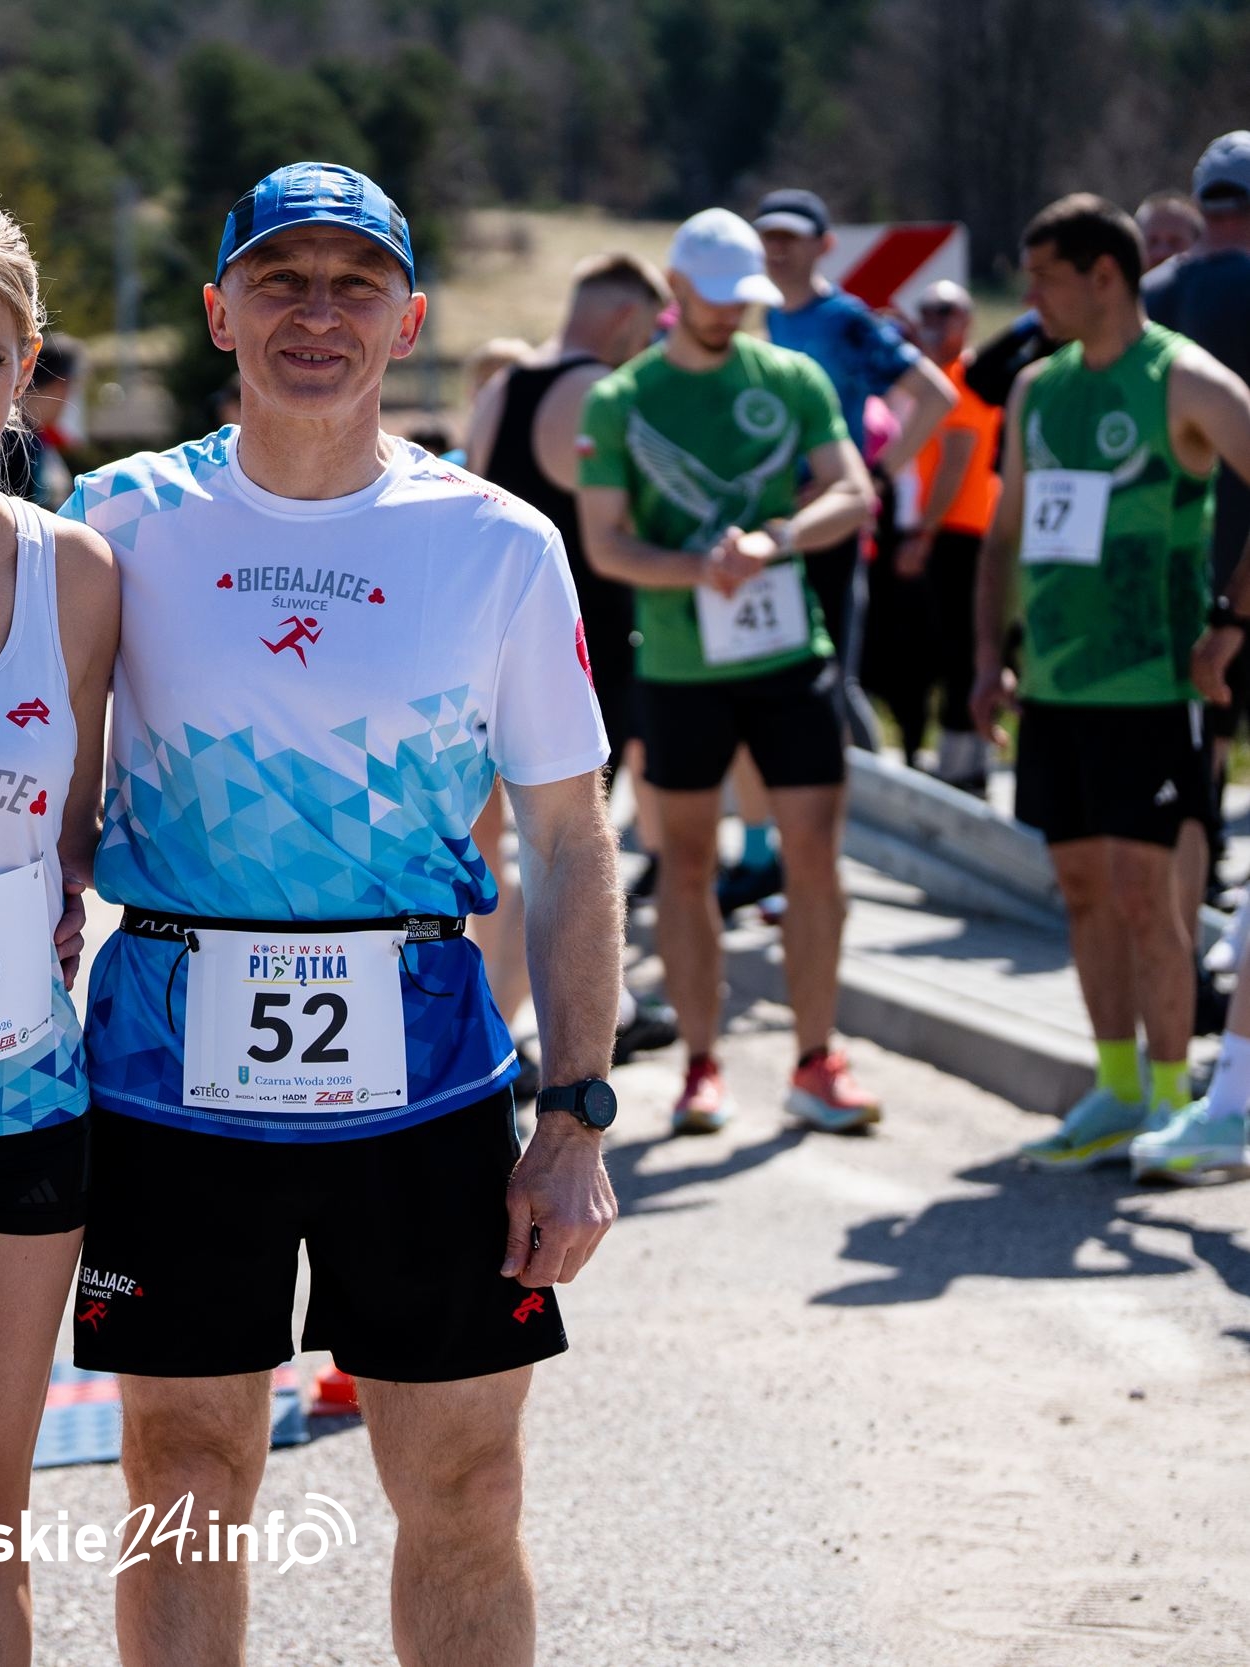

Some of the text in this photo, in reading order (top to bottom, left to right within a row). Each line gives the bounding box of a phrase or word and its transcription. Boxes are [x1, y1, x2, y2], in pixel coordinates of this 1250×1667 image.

[237, 566, 370, 604] BIEGAJĄCE
[272, 595, 328, 611] ŚLIWICE
[735, 598, 778, 630] 41
[246, 992, 349, 1064] 52
[195, 1084, 230, 1099] STEICO
[254, 1075, 352, 1086] Czarna Woda 2026
[78, 1265, 136, 1296] EGAJĄCE
[81, 1284, 112, 1300] ŚLIWICE
